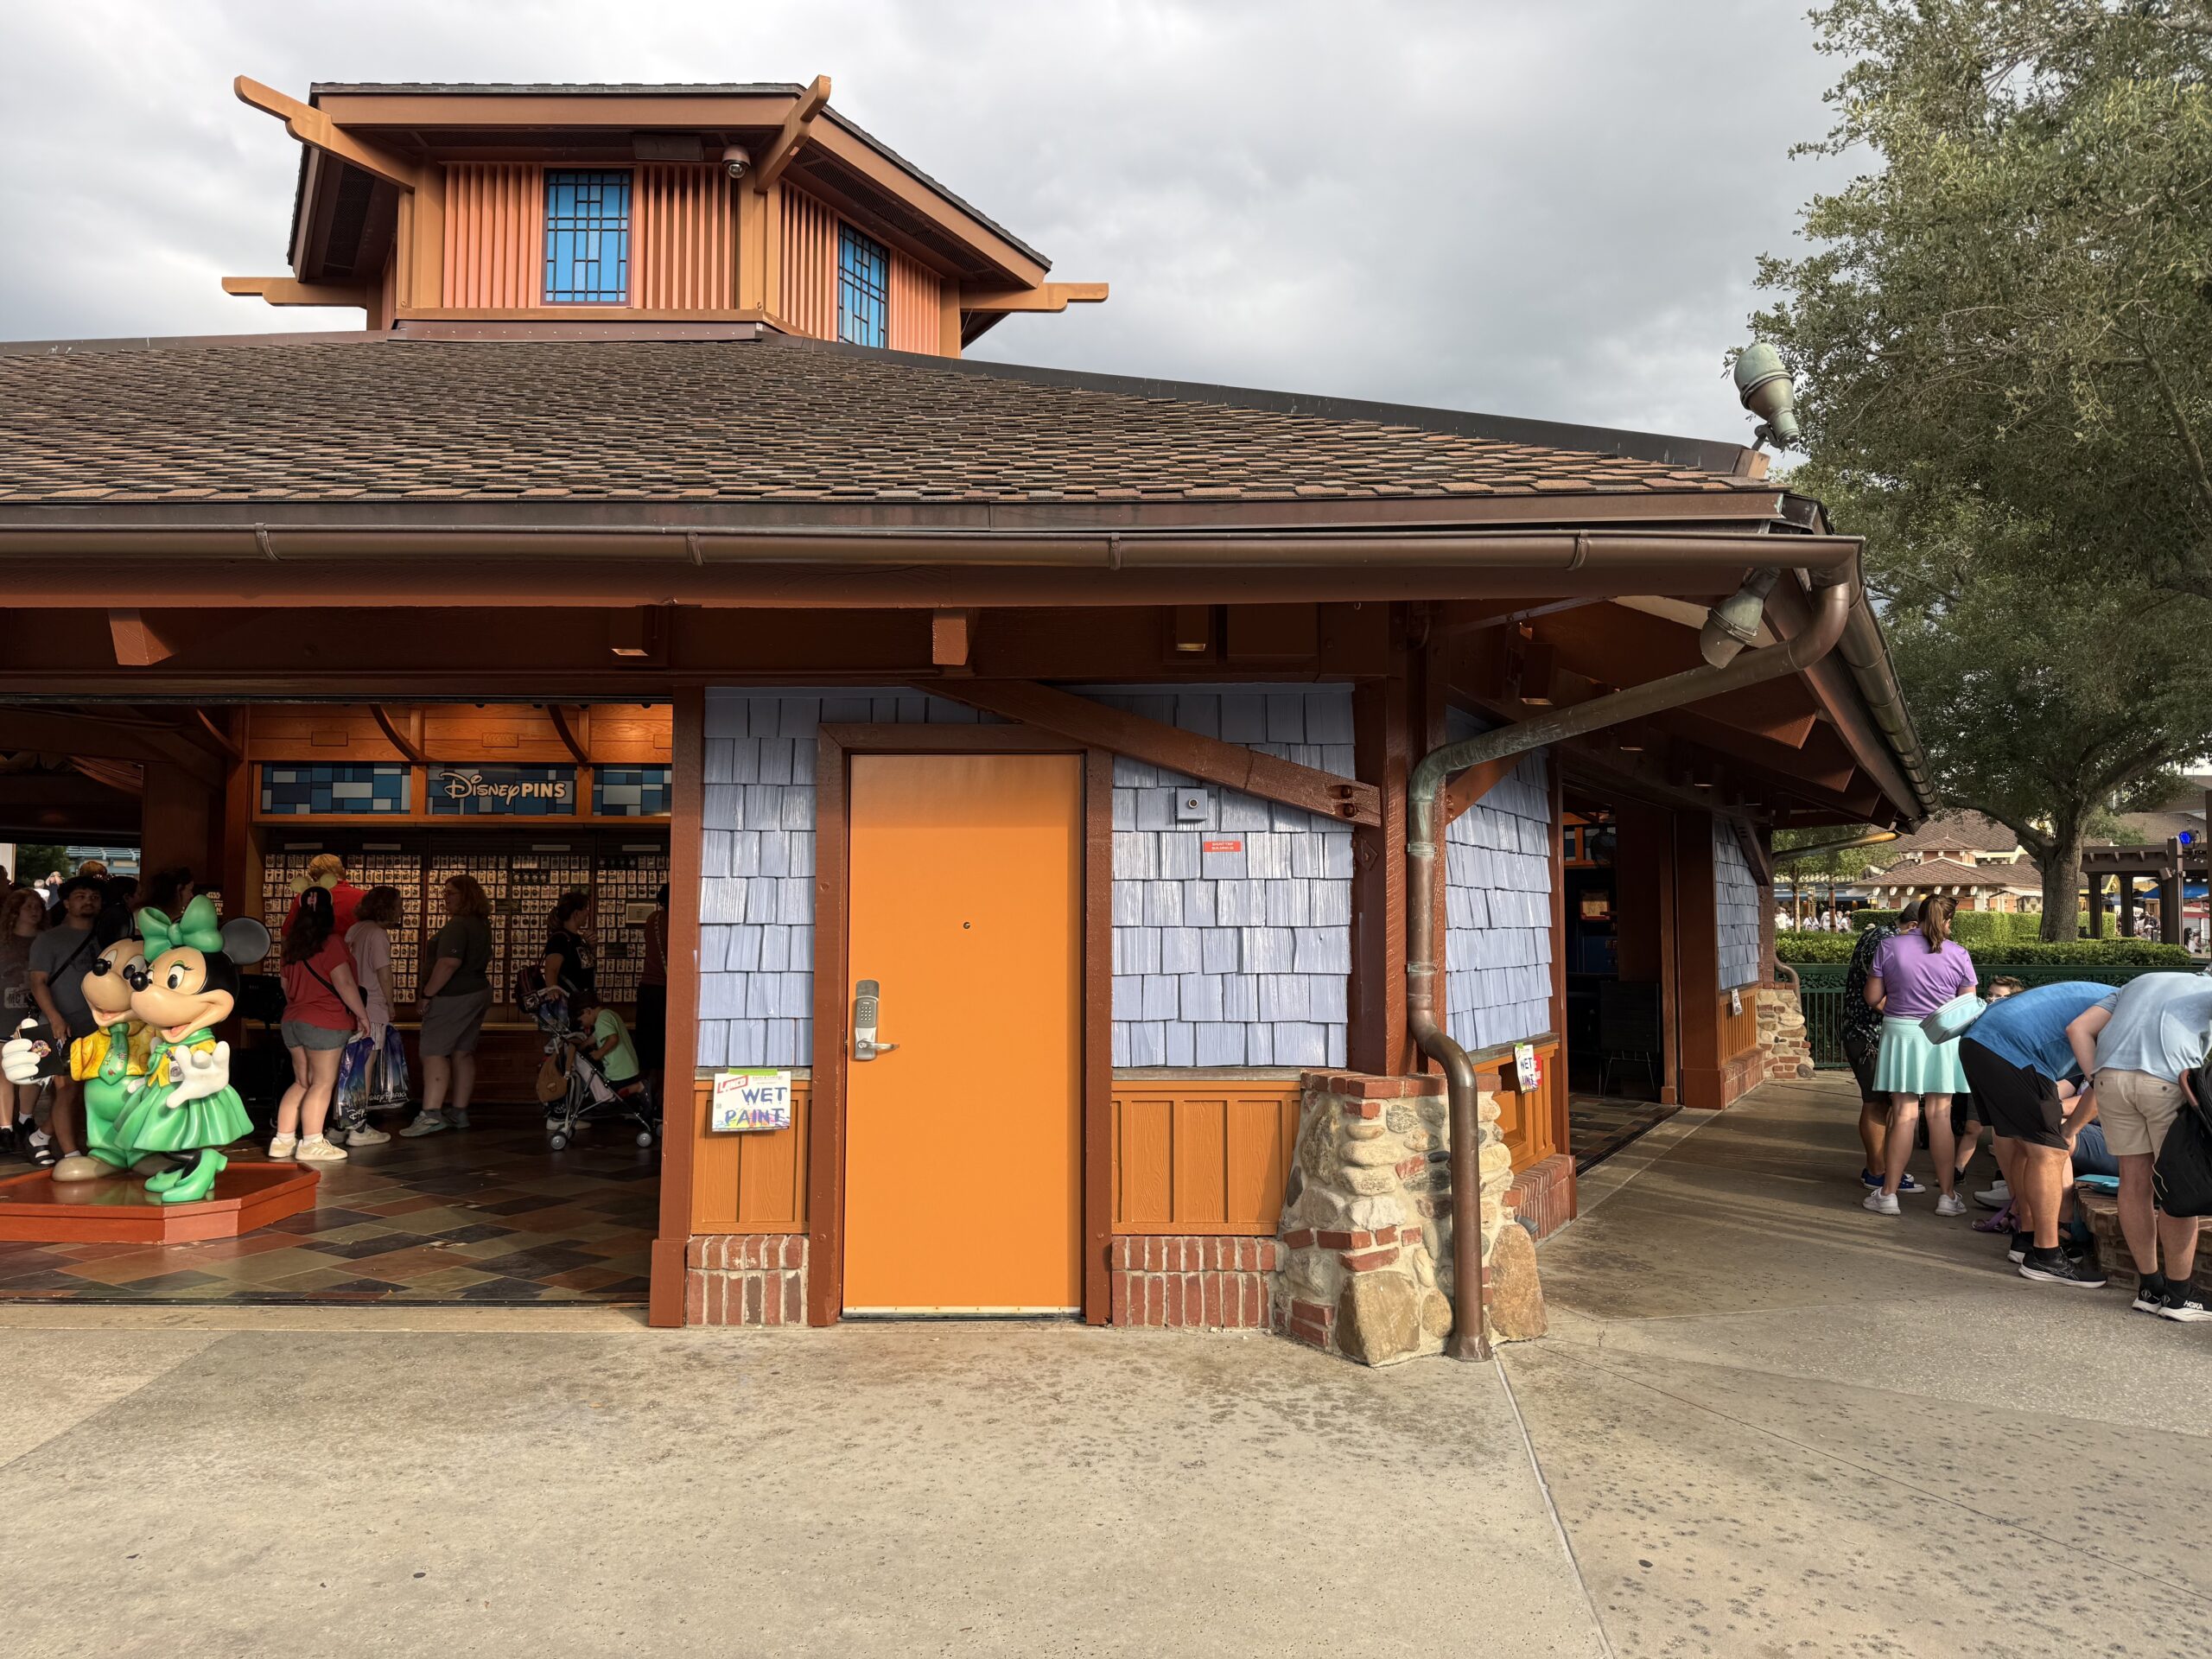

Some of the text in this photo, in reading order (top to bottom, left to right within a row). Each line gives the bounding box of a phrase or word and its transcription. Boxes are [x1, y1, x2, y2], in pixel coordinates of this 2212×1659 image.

[521, 783, 566, 798] PINS
[741, 1087, 788, 1105] WET
[724, 1108, 785, 1126] PAINT
[2183, 1300, 2204, 1311] HOKA
